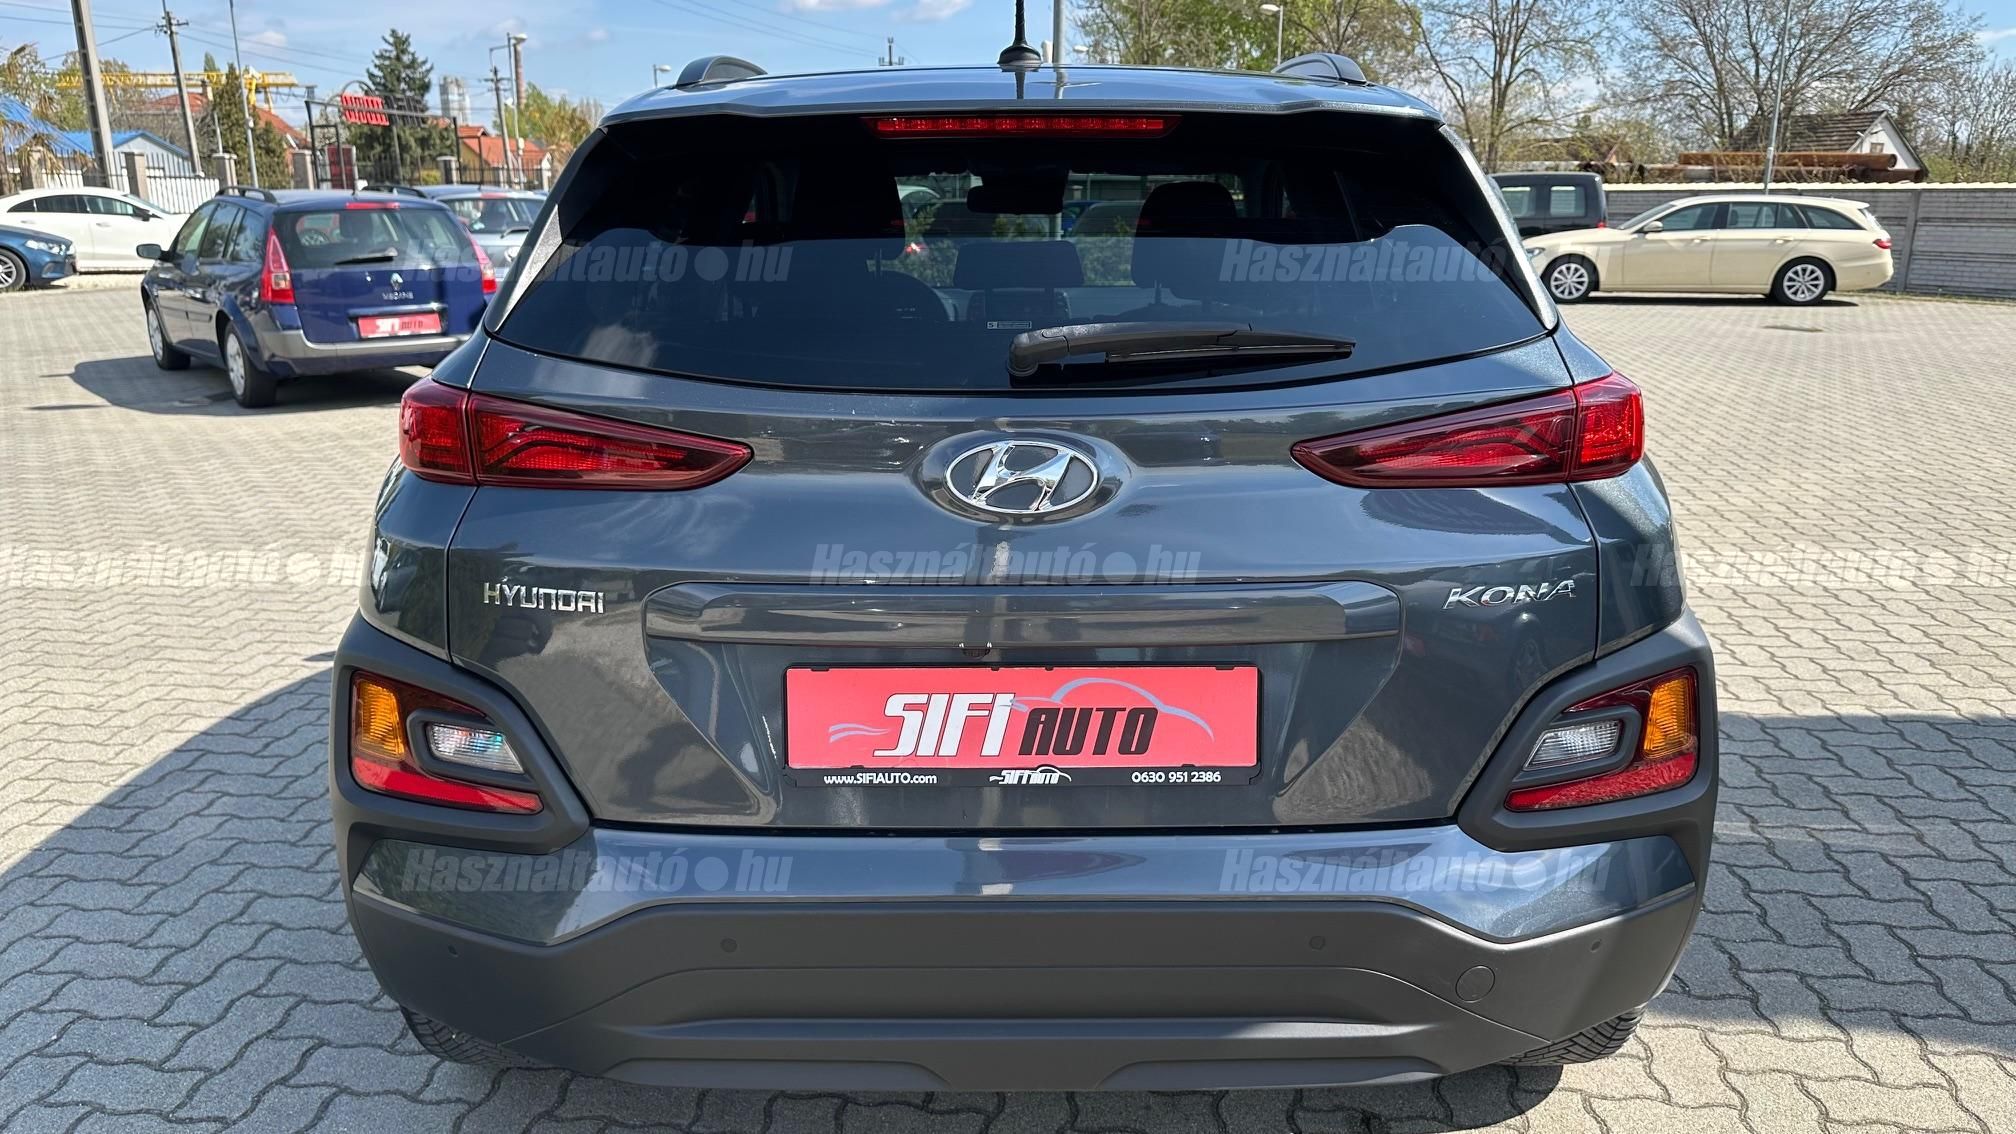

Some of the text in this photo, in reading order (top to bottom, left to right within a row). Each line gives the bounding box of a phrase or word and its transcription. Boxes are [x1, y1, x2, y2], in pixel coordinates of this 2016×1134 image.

[483, 582, 604, 614] HYUNDAI
[1441, 579, 1577, 609] KONA
[872, 692, 1159, 758] SIFI AUTO
[823, 771, 938, 785] www.SIFIAUTO.com
[1131, 771, 1222, 783] 0630 951 2386
